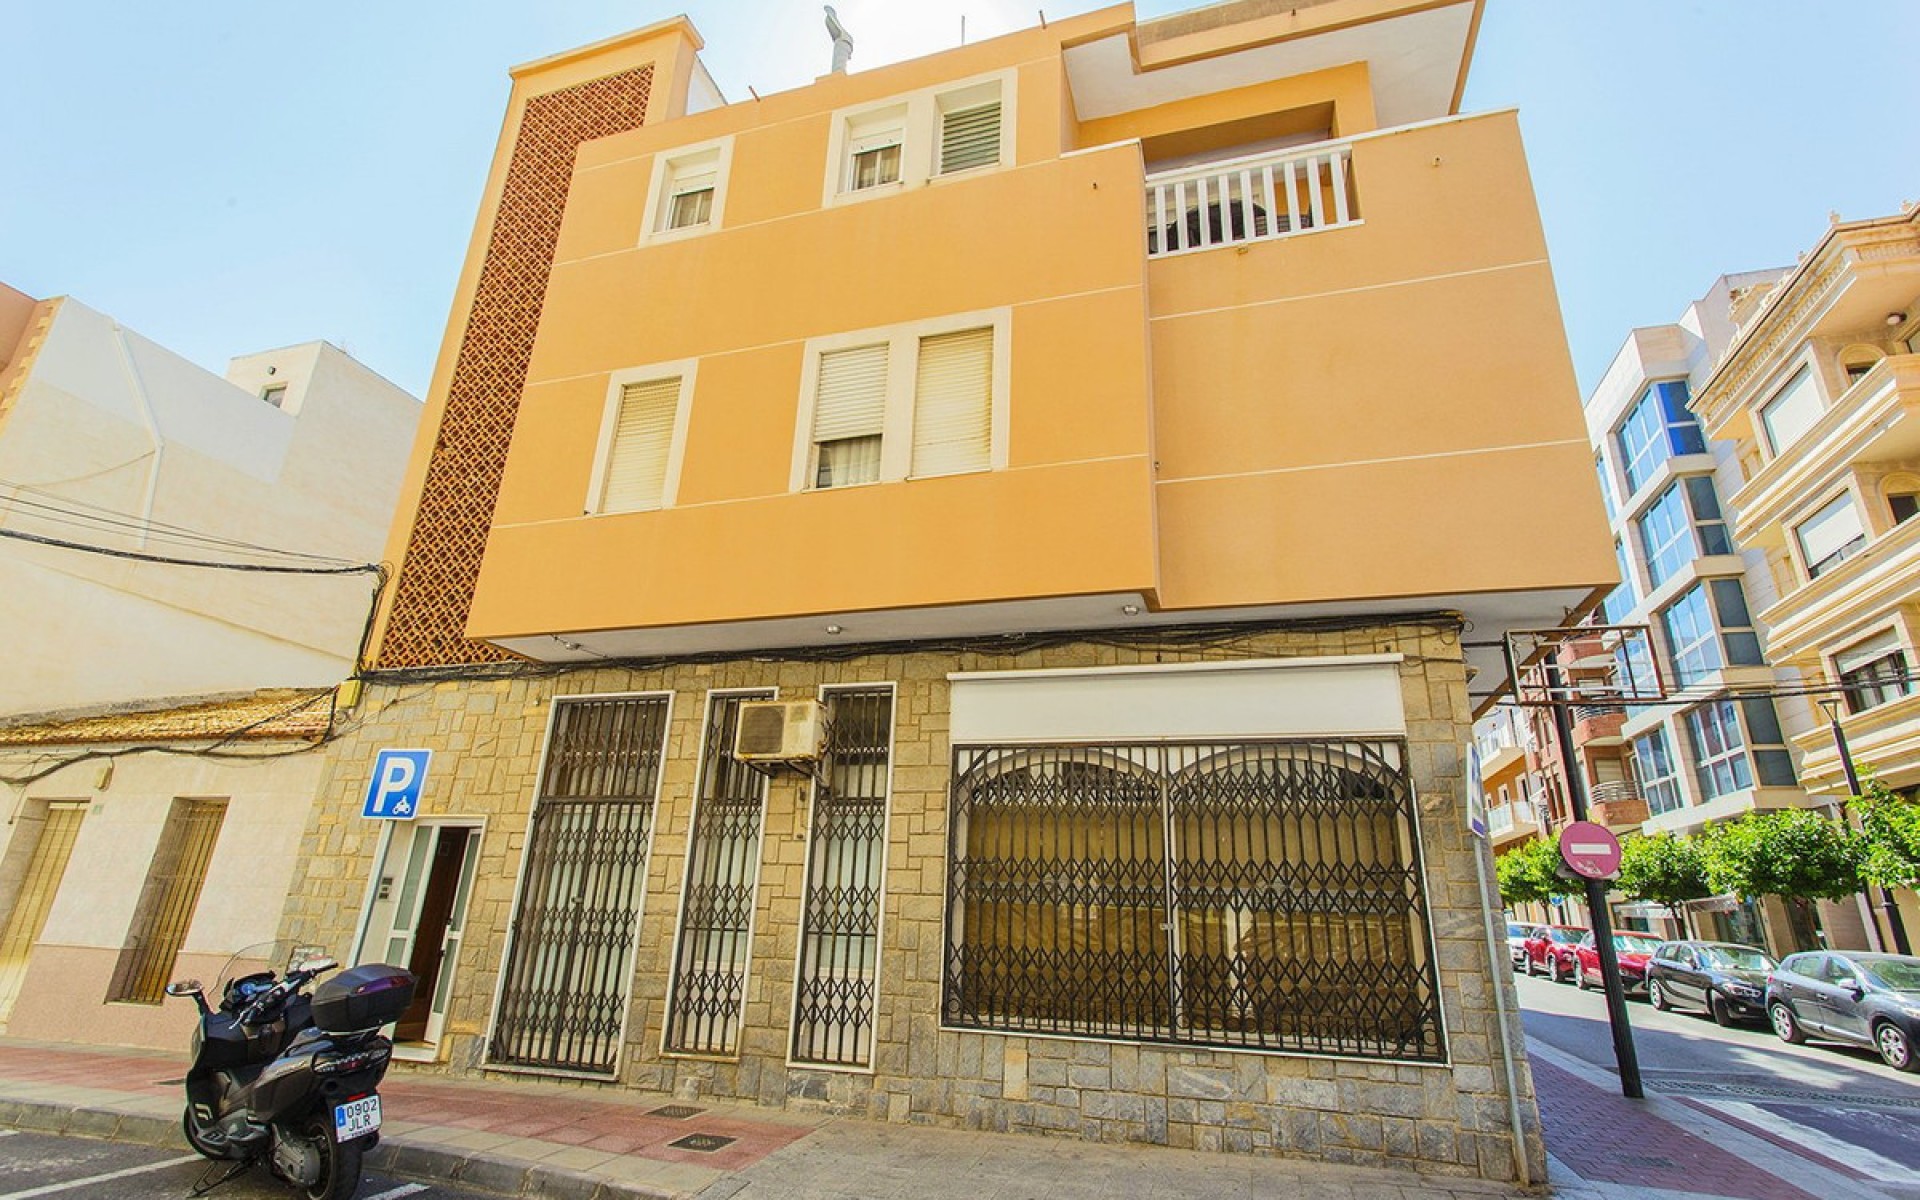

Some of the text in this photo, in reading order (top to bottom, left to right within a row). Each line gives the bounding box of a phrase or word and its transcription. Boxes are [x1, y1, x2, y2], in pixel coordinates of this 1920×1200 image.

[373, 757, 416, 813] P
[347, 1099, 377, 1118] 0902
[349, 1114, 371, 1131] JLR
